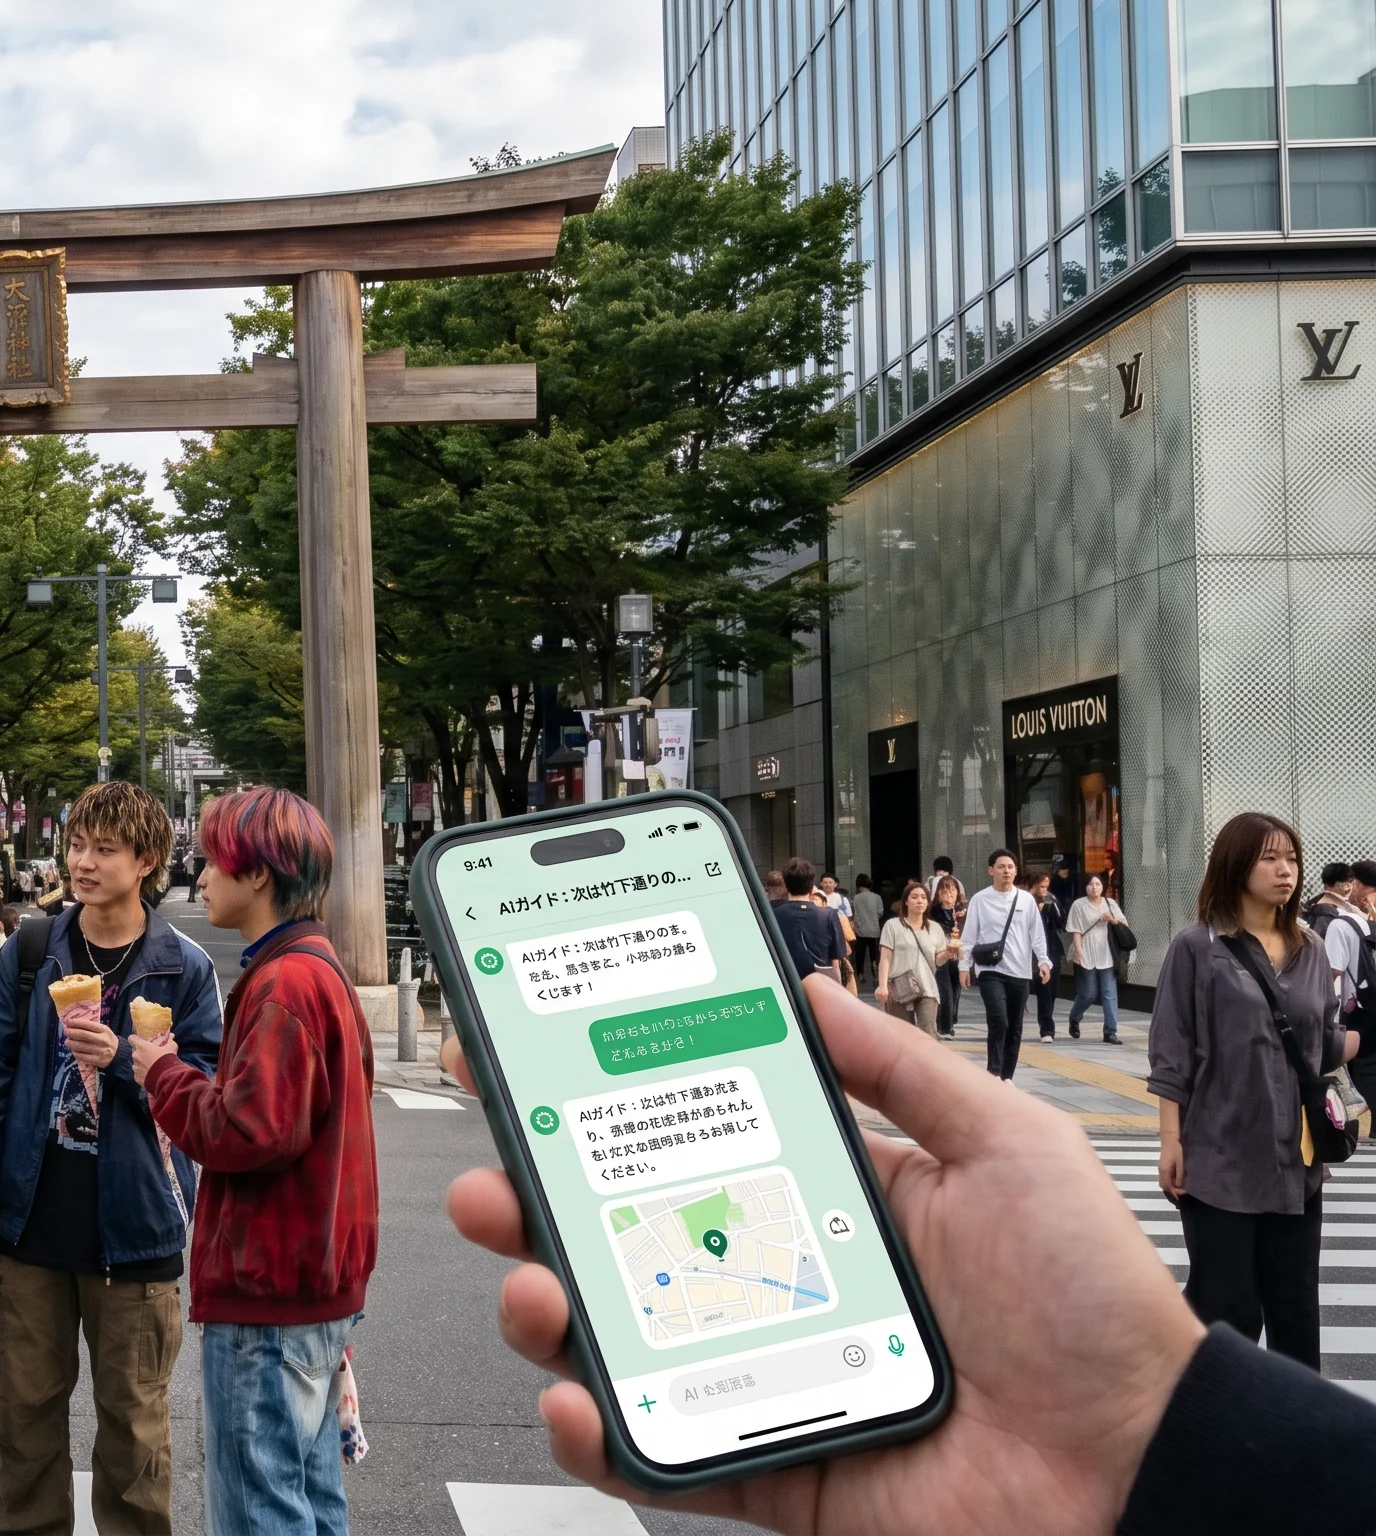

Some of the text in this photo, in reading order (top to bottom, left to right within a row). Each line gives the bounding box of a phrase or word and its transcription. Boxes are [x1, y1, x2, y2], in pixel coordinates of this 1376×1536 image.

[1012, 695, 1107, 739] LOUIS VUITTON
[463, 856, 493, 872] 9:41
[601, 1162, 657, 1181] ください。
[685, 1386, 699, 1402] AI
